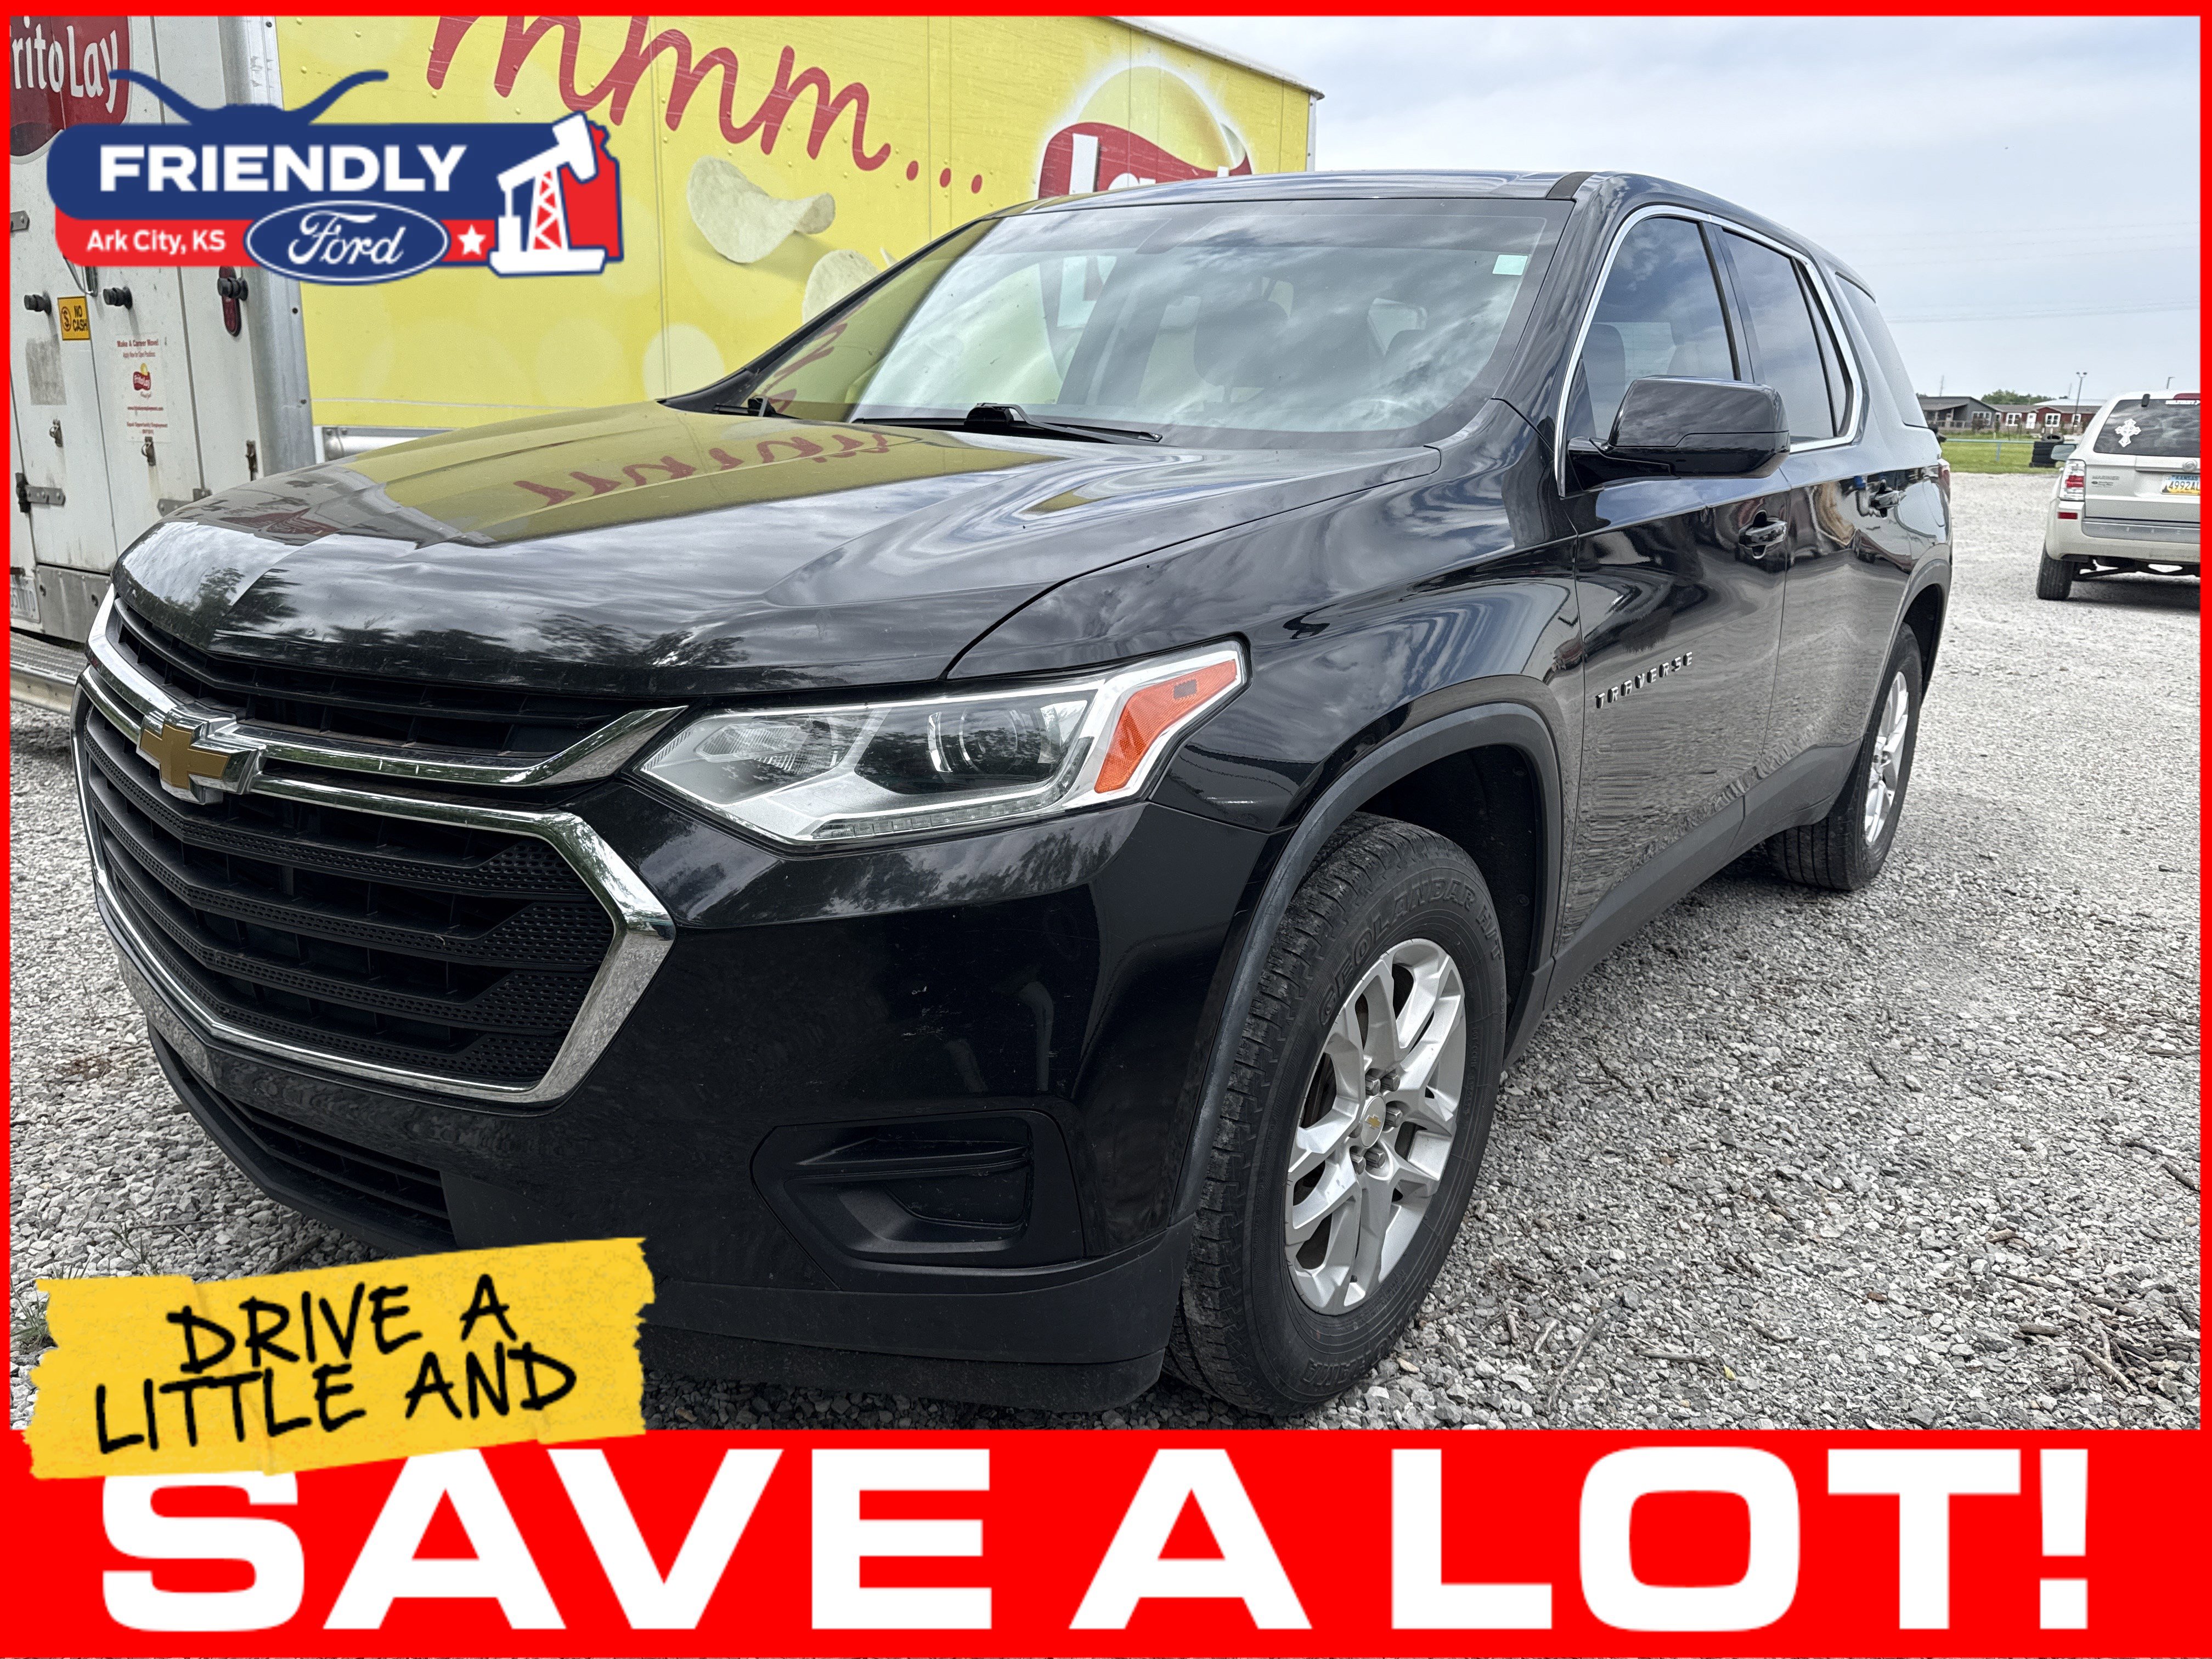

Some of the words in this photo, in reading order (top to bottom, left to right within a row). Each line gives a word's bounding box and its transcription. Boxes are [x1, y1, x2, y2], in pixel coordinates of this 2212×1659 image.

[10, 15, 118, 114] ritoLay
[72, 319, 88, 331] CASH
[73, 305, 82, 318] NO
[1595, 652, 1692, 709] TRAVERSE
[1318, 877, 1476, 1026] GEOLANDAR
